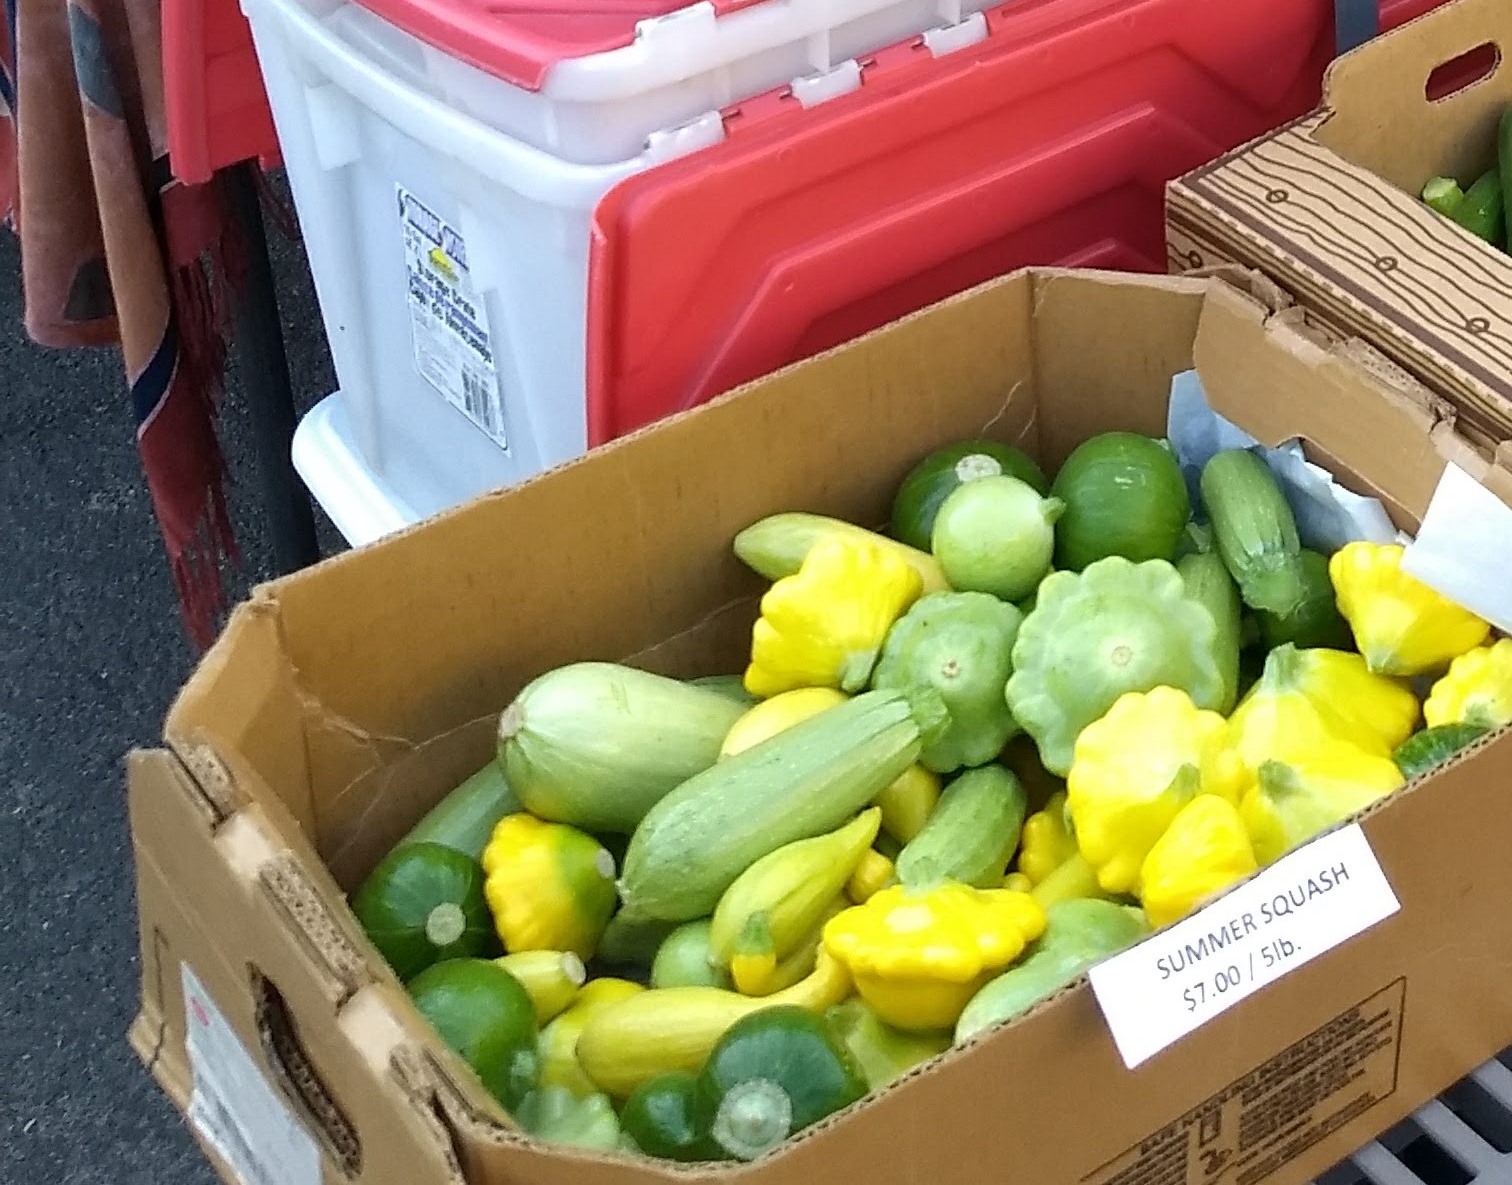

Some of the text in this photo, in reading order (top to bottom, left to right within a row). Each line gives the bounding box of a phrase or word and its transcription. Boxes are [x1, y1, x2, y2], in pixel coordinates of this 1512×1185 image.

[1157, 862, 1350, 980] SUMMER SQUASH
[1183, 938, 1302, 1012] $7.00 / 5lb.
